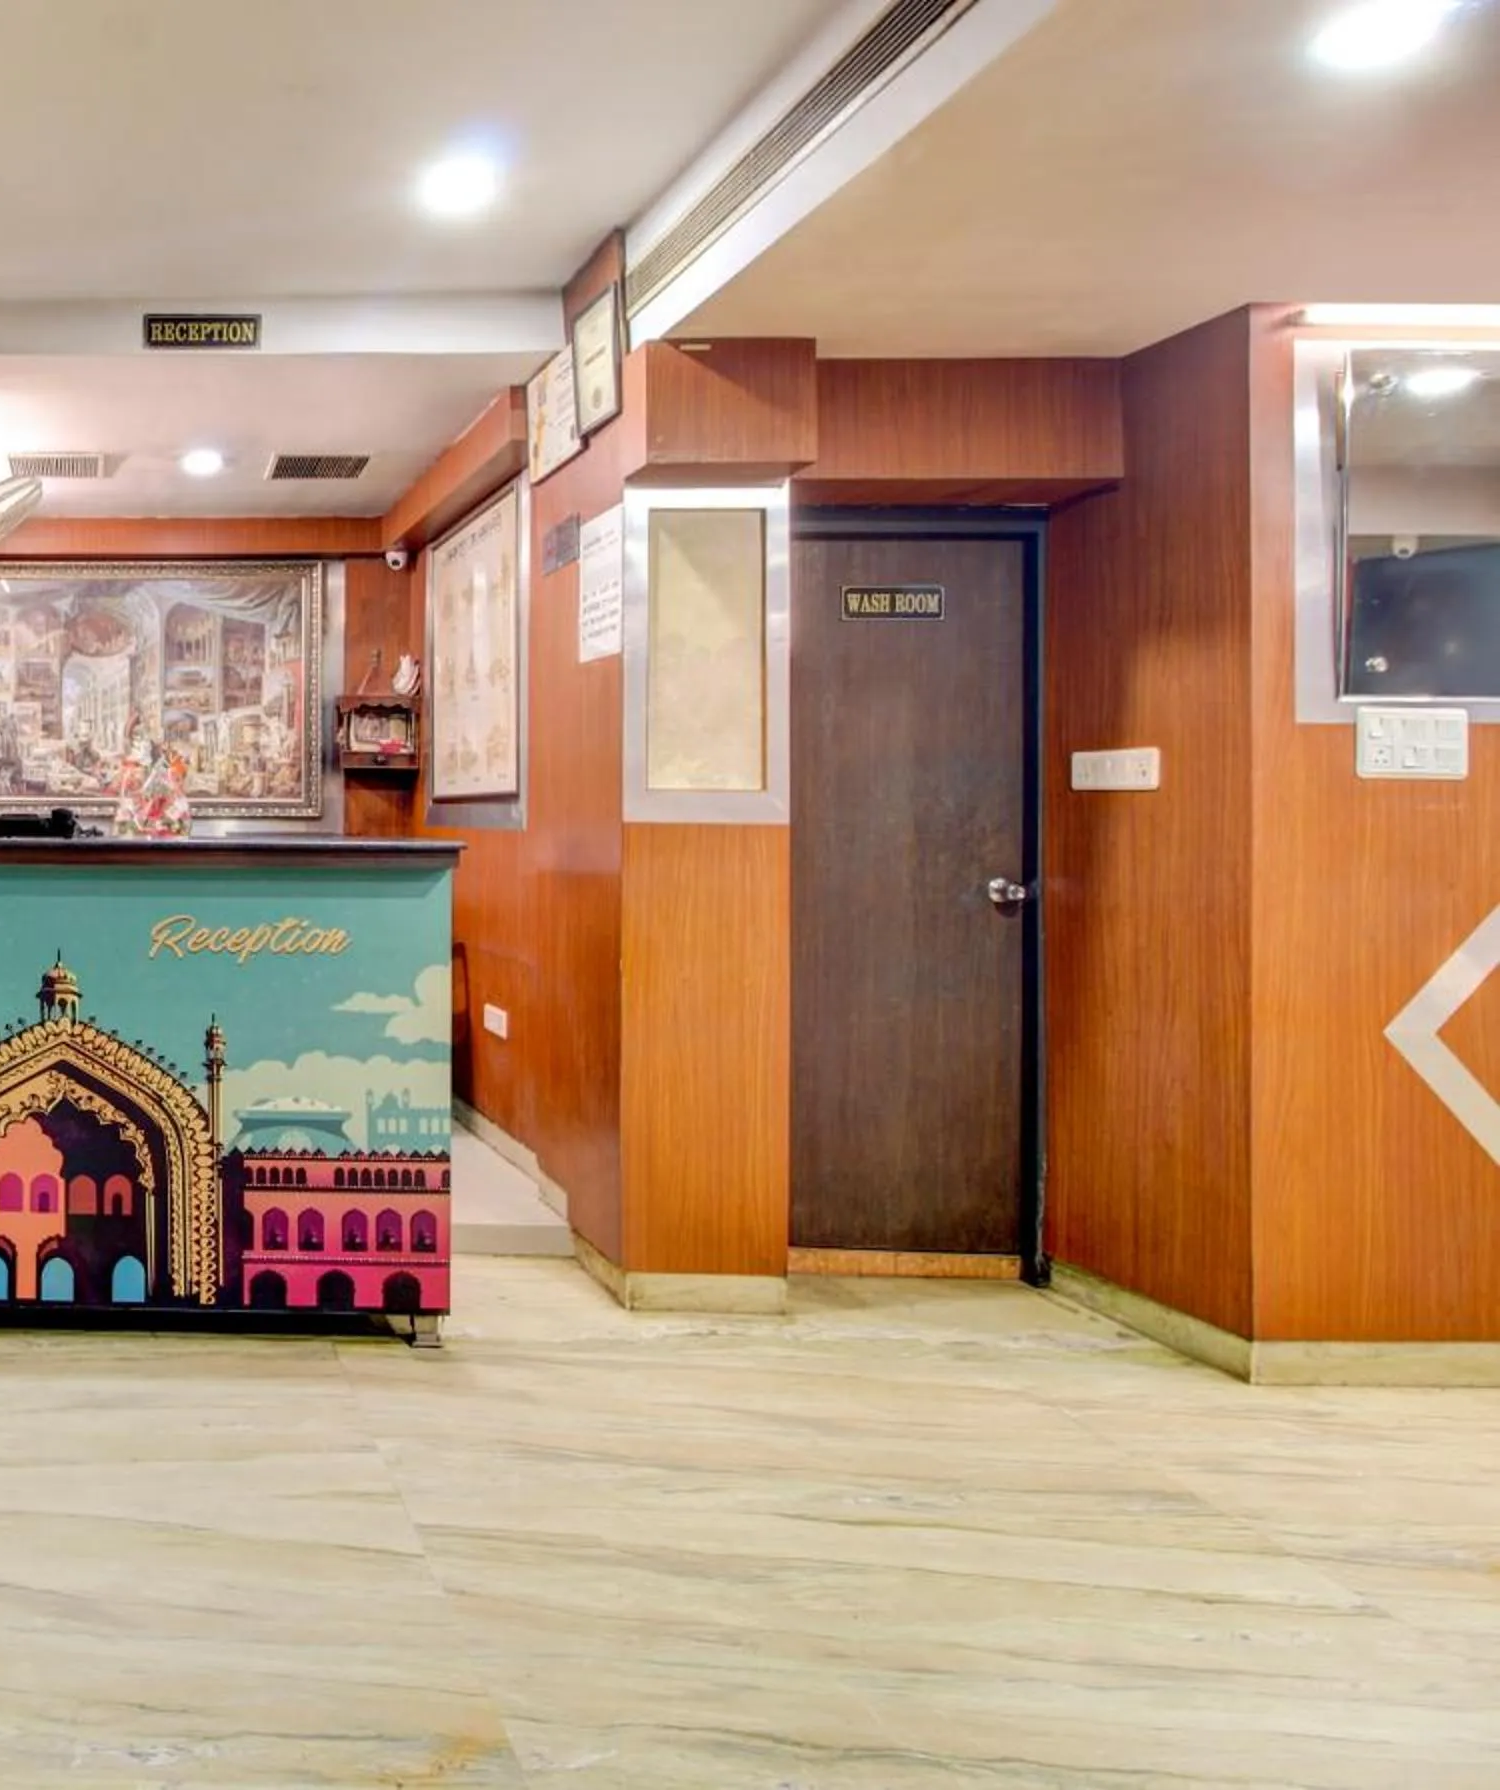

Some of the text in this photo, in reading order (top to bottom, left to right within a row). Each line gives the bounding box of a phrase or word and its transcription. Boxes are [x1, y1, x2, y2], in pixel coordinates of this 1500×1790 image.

[150, 321, 255, 342] RECEPTION
[846, 593, 940, 613] WASH ROOM
[149, 914, 352, 965] Reception
